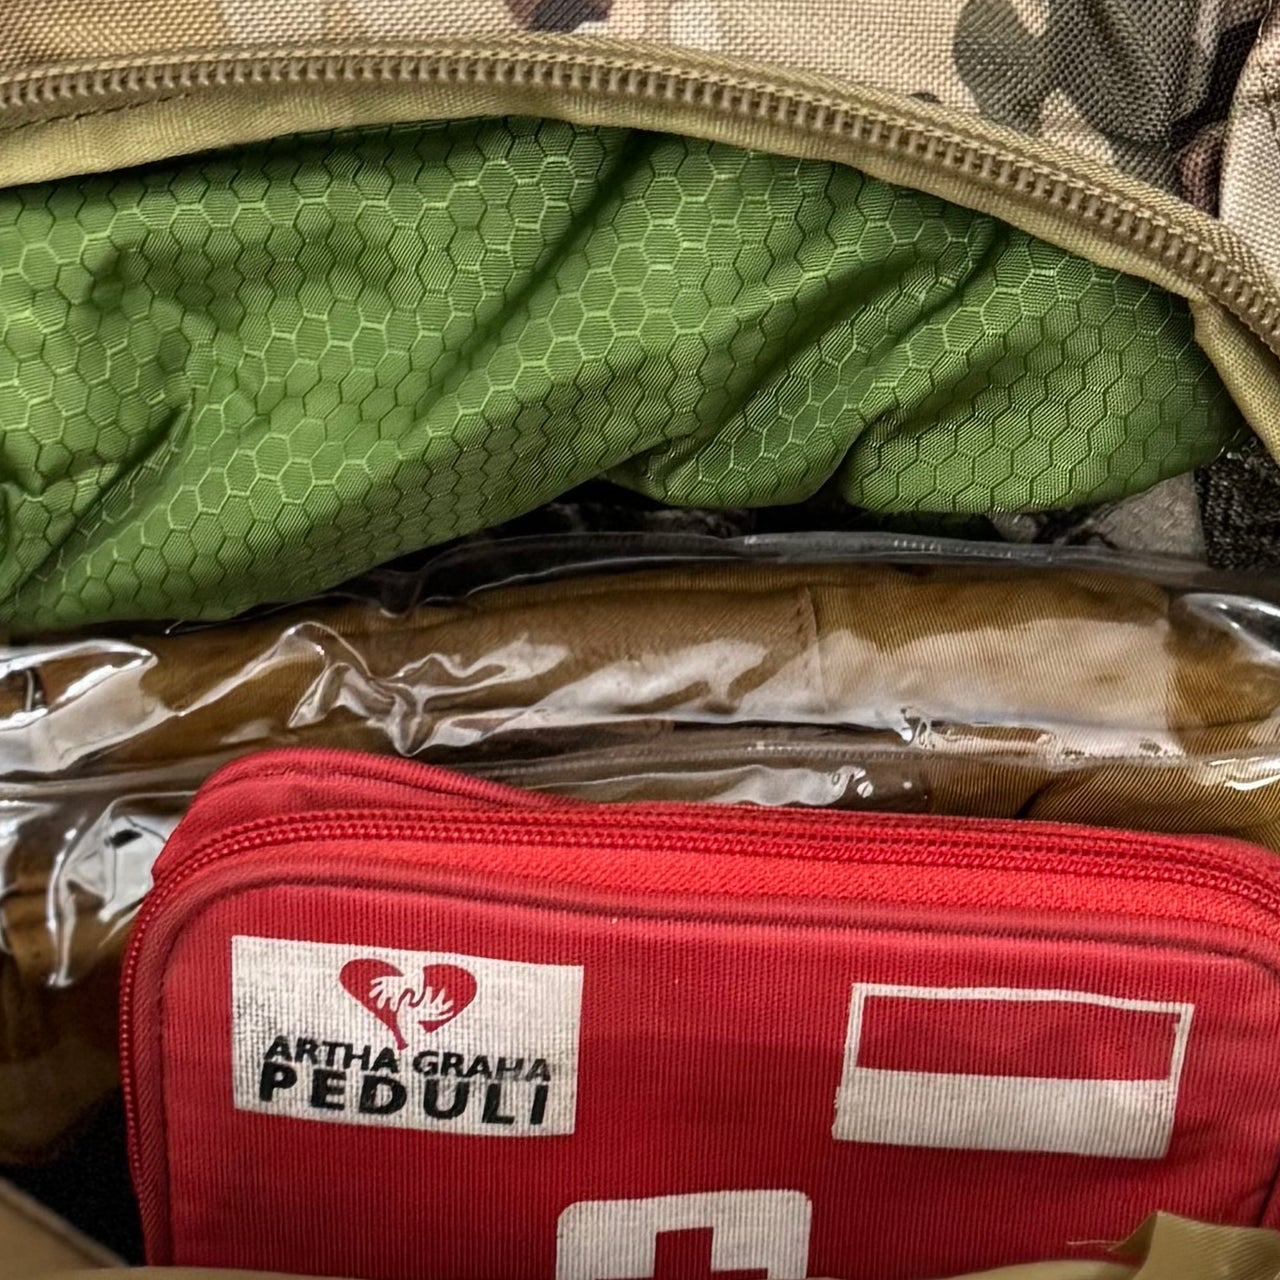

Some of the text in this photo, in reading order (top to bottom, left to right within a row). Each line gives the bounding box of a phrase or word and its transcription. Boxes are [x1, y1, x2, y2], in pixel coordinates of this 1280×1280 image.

[264, 1035, 551, 1082] ARTHA GRAHA
[259, 1061, 549, 1125] PEDULI
